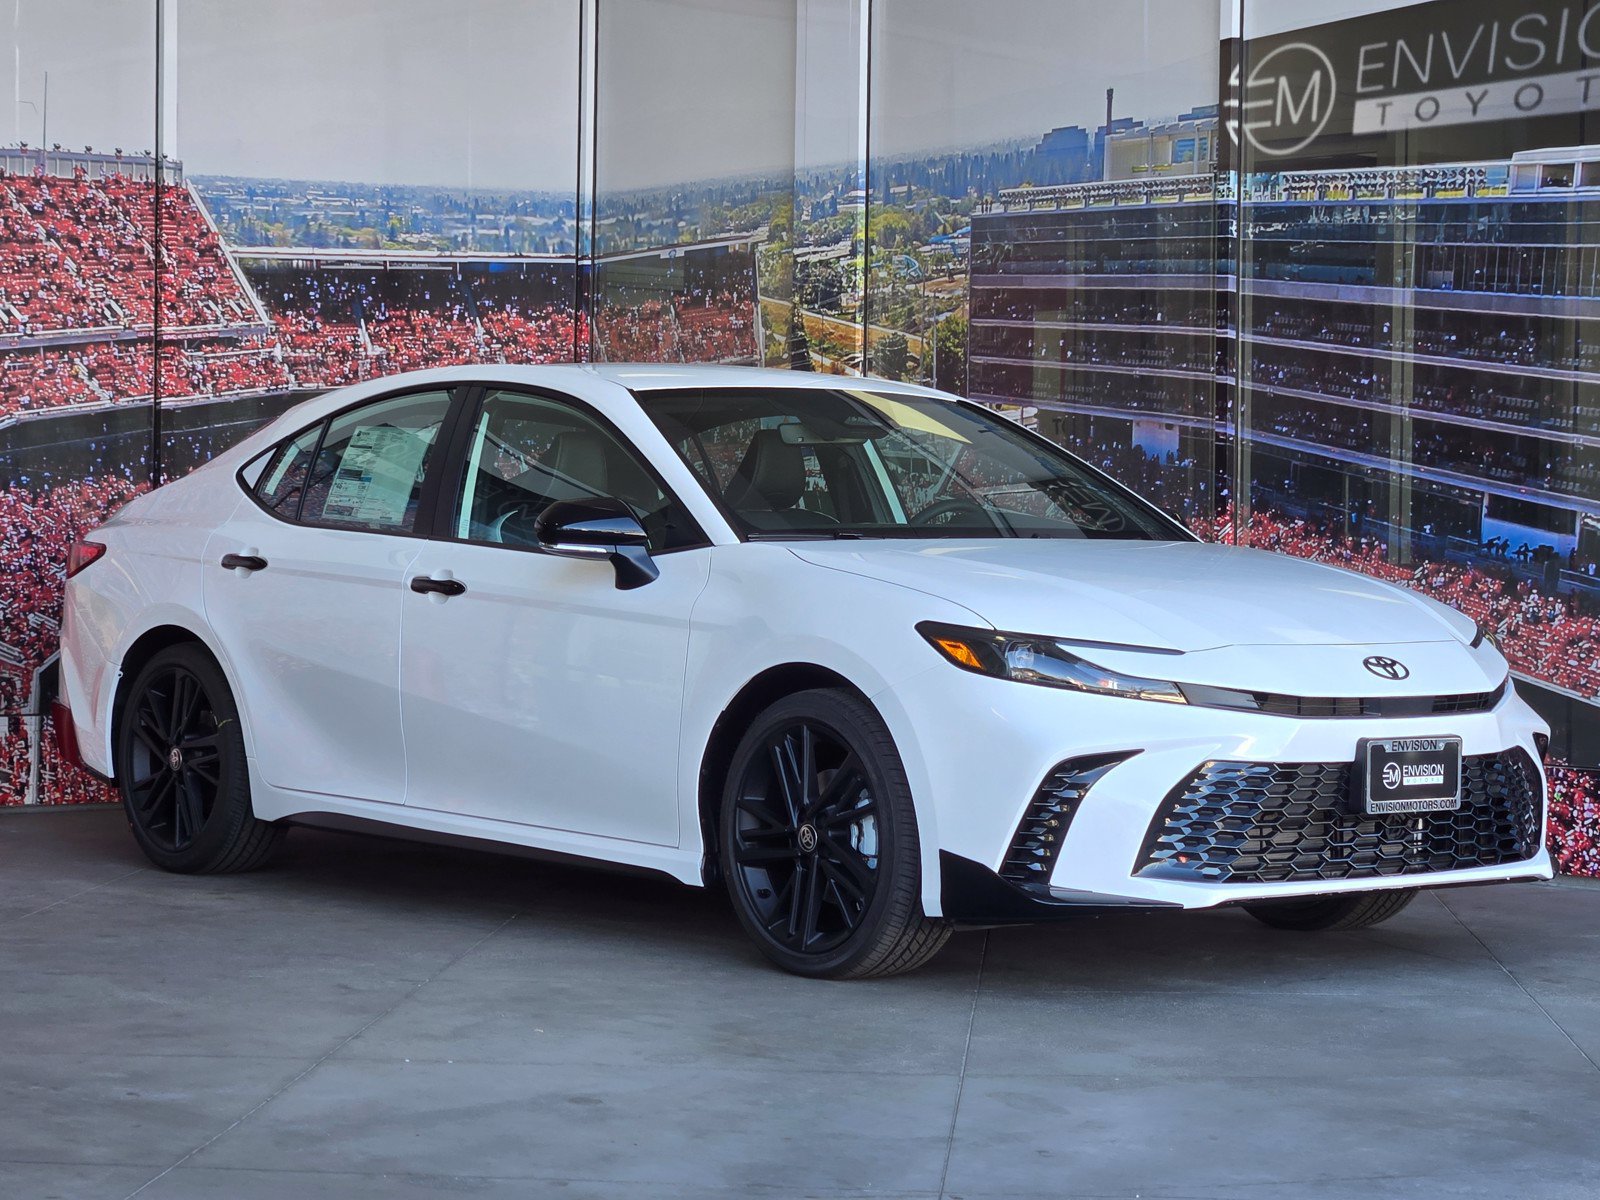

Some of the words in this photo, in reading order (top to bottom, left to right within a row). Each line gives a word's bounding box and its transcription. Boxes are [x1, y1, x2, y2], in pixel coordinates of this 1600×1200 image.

[1391, 739, 1438, 752] ENVISION
[1402, 763, 1445, 777] ENVISION
[1370, 798, 1457, 813] ENVISIONMOTORS.COM
